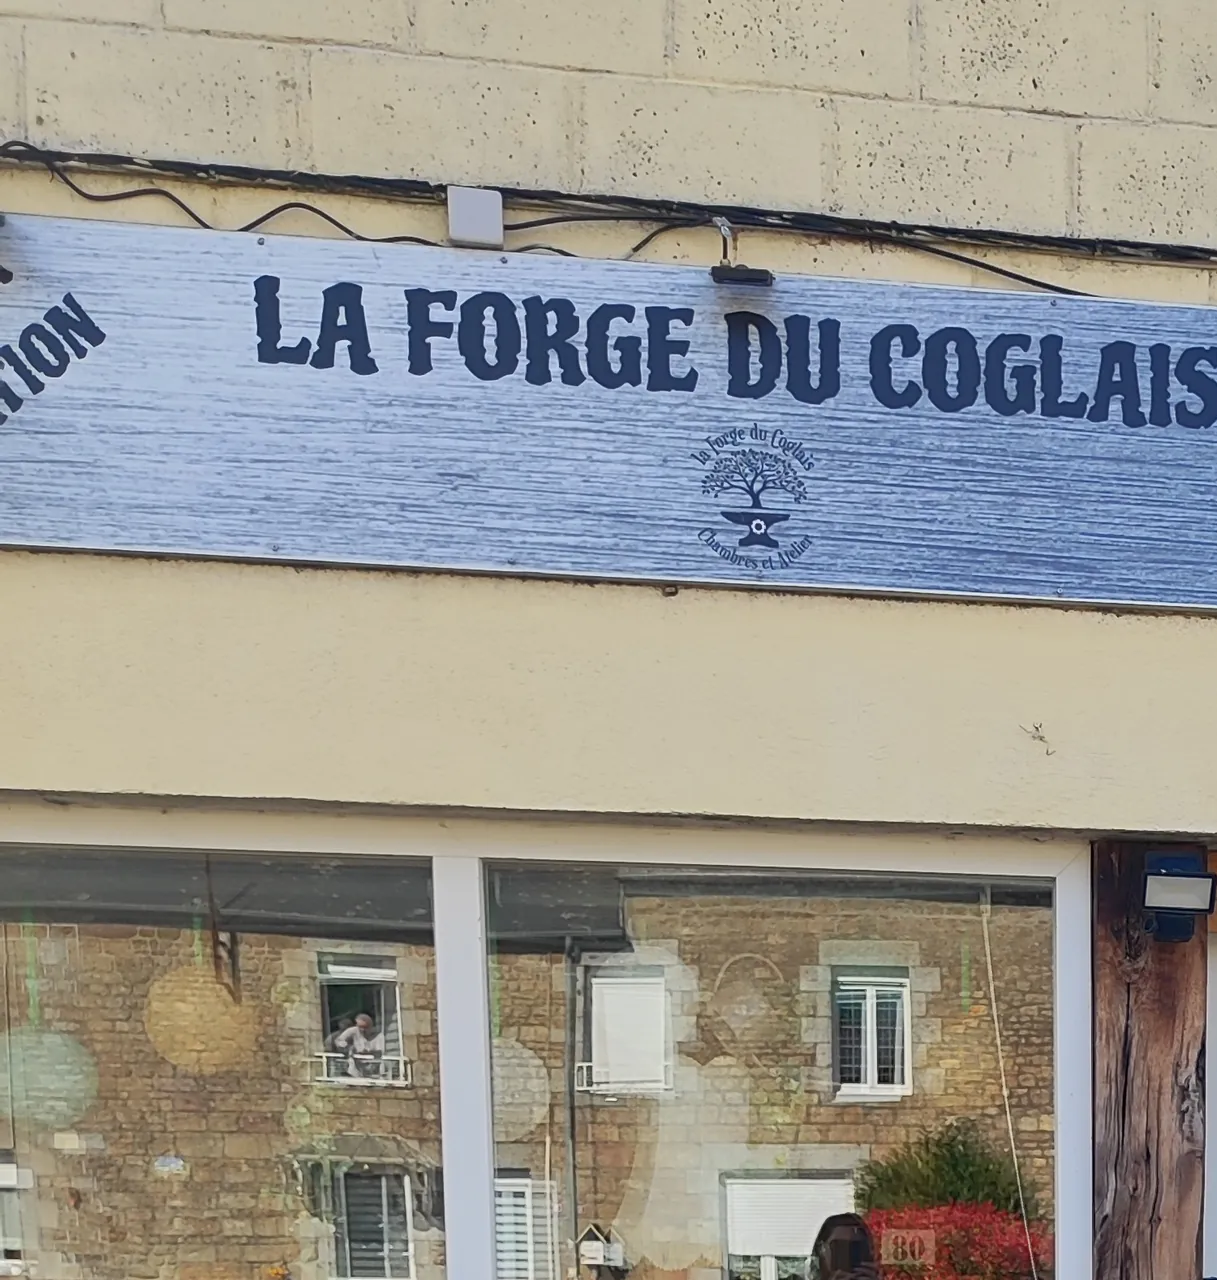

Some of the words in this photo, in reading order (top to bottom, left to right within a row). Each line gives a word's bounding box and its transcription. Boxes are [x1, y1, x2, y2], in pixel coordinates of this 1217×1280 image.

[254, 275, 379, 376] LA
[404, 288, 699, 392] FORGE
[725, 311, 841, 404] DU
[691, 451, 711, 466] la
[704, 428, 745, 456] Forge
[750, 422, 767, 441] du
[771, 429, 815, 471] Coglais
[697, 527, 758, 570] Chambres
[762, 555, 774, 570] et
[777, 534, 813, 569] Atelier
[892, 1235, 926, 1261] 80
